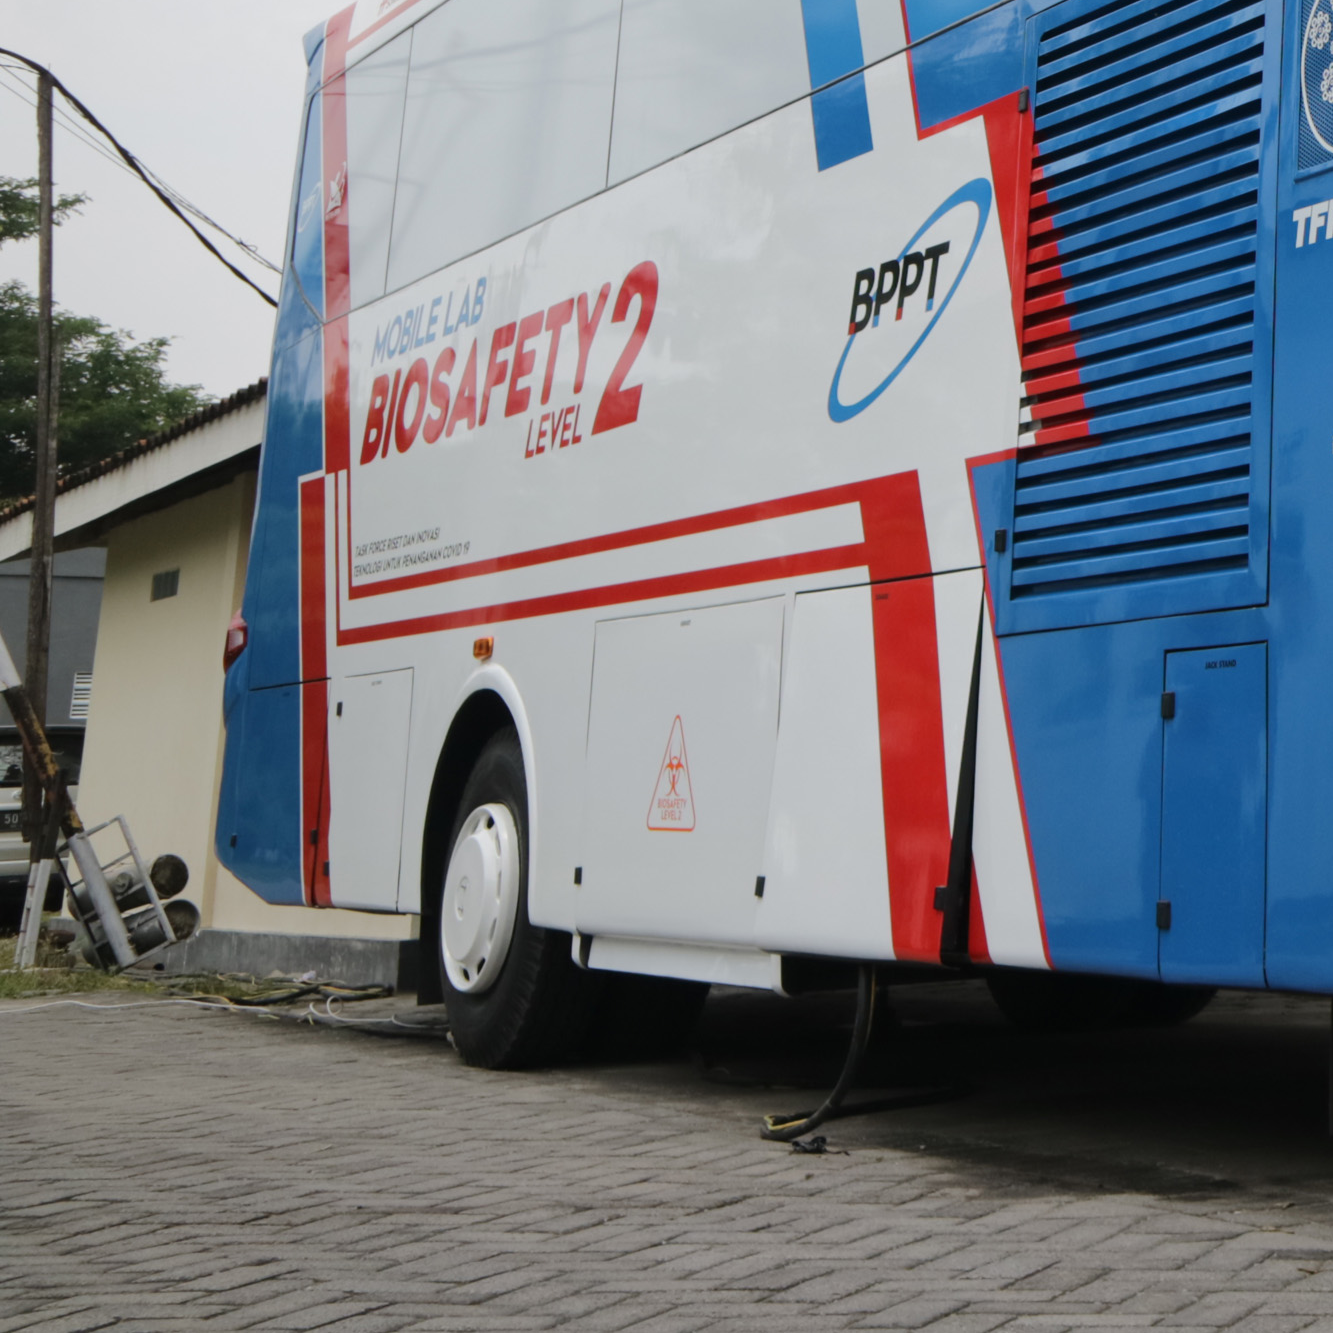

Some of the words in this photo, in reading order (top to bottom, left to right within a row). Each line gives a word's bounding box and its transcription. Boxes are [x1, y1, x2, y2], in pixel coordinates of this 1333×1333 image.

[371, 295, 443, 367] MOBILE
[442, 276, 487, 337] LAB
[847, 239, 951, 336] BPPT
[359, 281, 612, 466] BIOSAFETY
[591, 260, 659, 437] 2
[524, 403, 583, 460] LEVEL
[657, 797, 688, 809] BIOSAFETY
[661, 809, 677, 821] LEVEL
